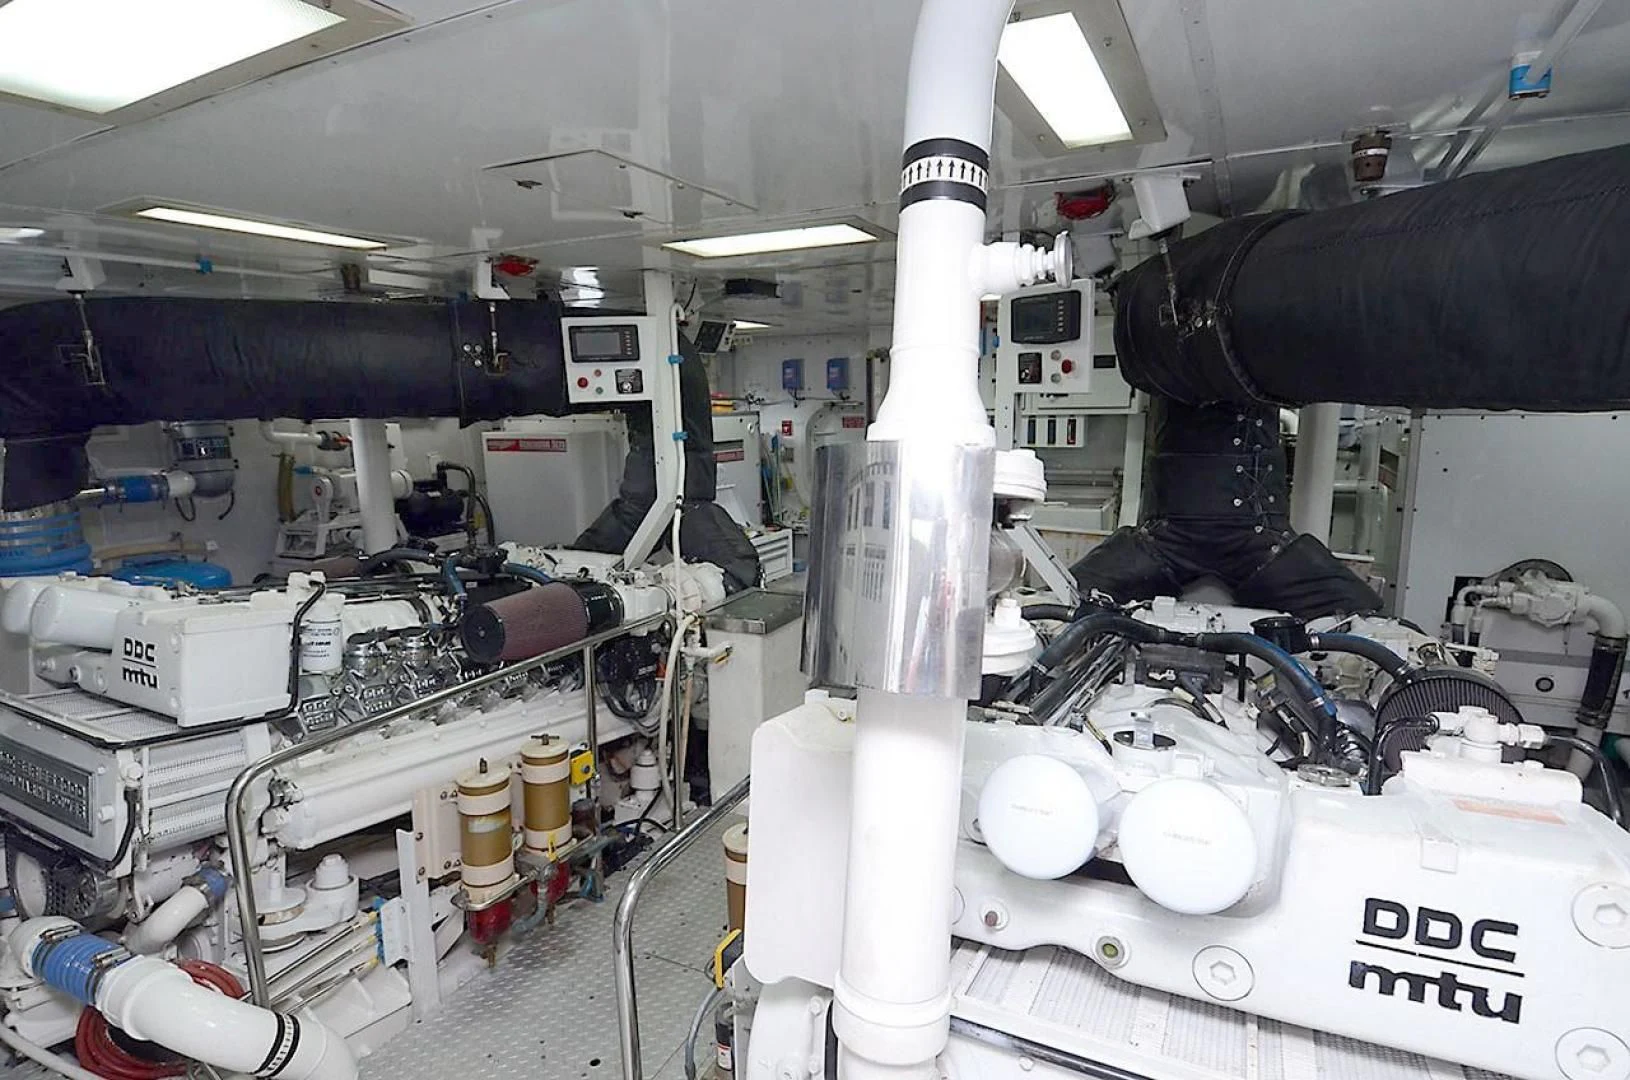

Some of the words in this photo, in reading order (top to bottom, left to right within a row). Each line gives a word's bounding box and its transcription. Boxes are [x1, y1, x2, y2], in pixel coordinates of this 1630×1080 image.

[124, 637, 155, 662] DDC
[122, 667, 158, 689] mtu
[1362, 897, 1519, 963] DDC
[1348, 960, 1523, 1024] mtu
